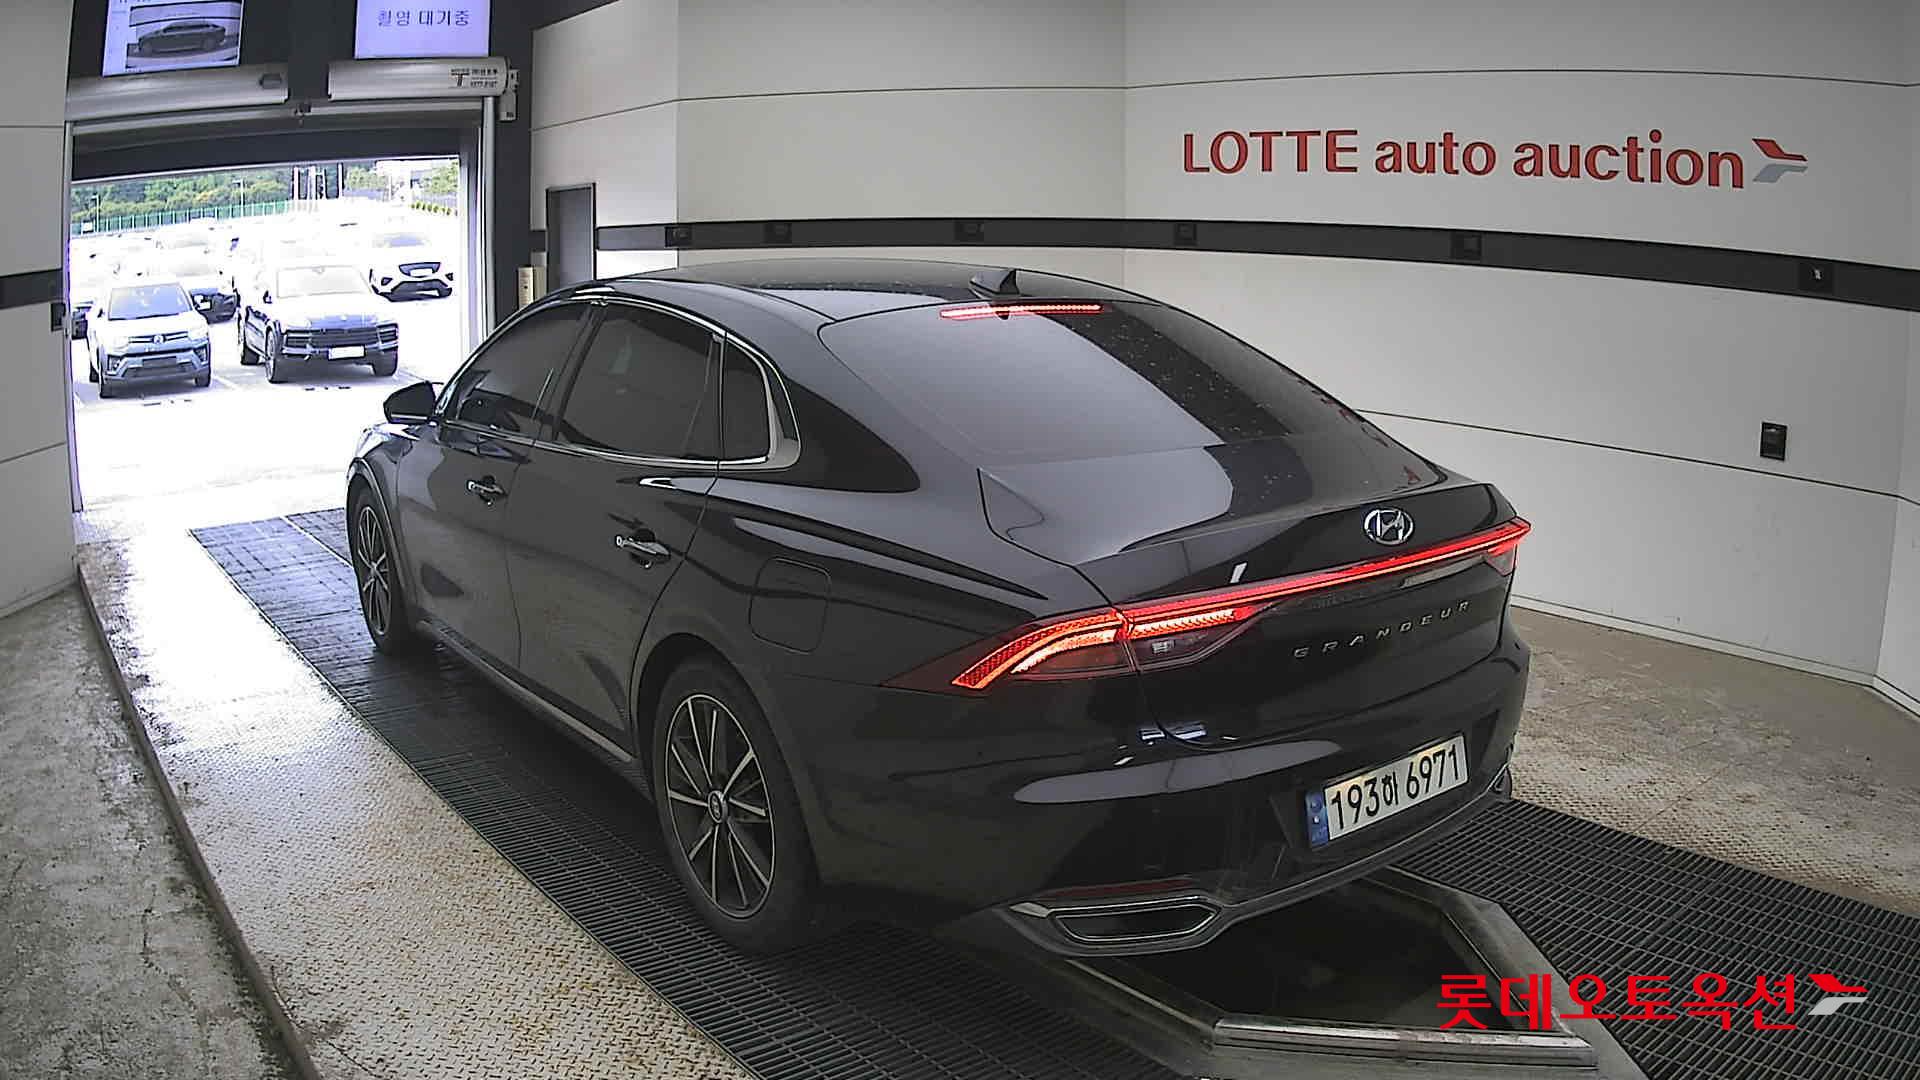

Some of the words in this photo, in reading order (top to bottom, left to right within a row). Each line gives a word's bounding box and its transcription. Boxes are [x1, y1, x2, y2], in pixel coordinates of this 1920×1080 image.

[418, 8, 470, 27] 대기중
[1184, 129, 1359, 175] LOTTE
[1375, 131, 1497, 177] auto
[1513, 129, 1745, 189] auction
[1294, 600, 1469, 659] GRANDEUR
[1331, 771, 1399, 830] 193하
[1406, 743, 1459, 800] 6971
